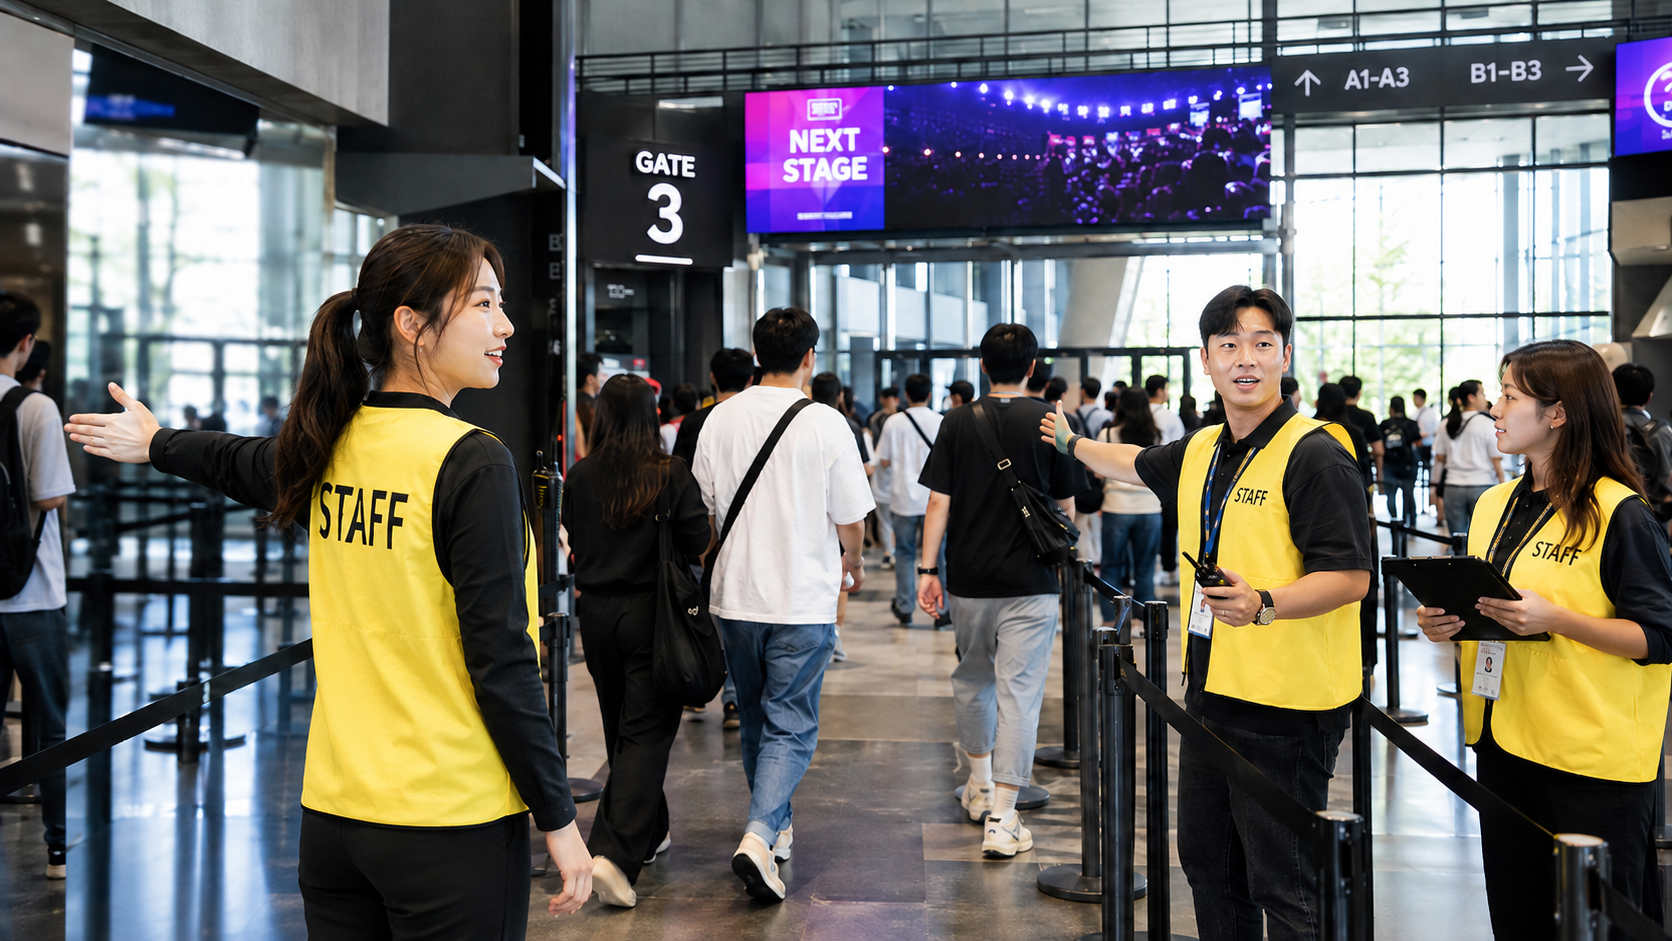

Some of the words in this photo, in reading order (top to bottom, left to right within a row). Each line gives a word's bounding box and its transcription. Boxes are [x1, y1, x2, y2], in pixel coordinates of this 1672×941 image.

[1344, 66, 1410, 91] A1-A3
[1470, 59, 1542, 84] B1-B3
[789, 127, 861, 154] NEXT
[635, 150, 696, 178] GATE
[782, 156, 868, 183] STAGE
[646, 182, 684, 245] 3
[1234, 487, 1269, 507] STAFF
[319, 481, 409, 550] STAFF
[1531, 541, 1583, 566] STAFF
